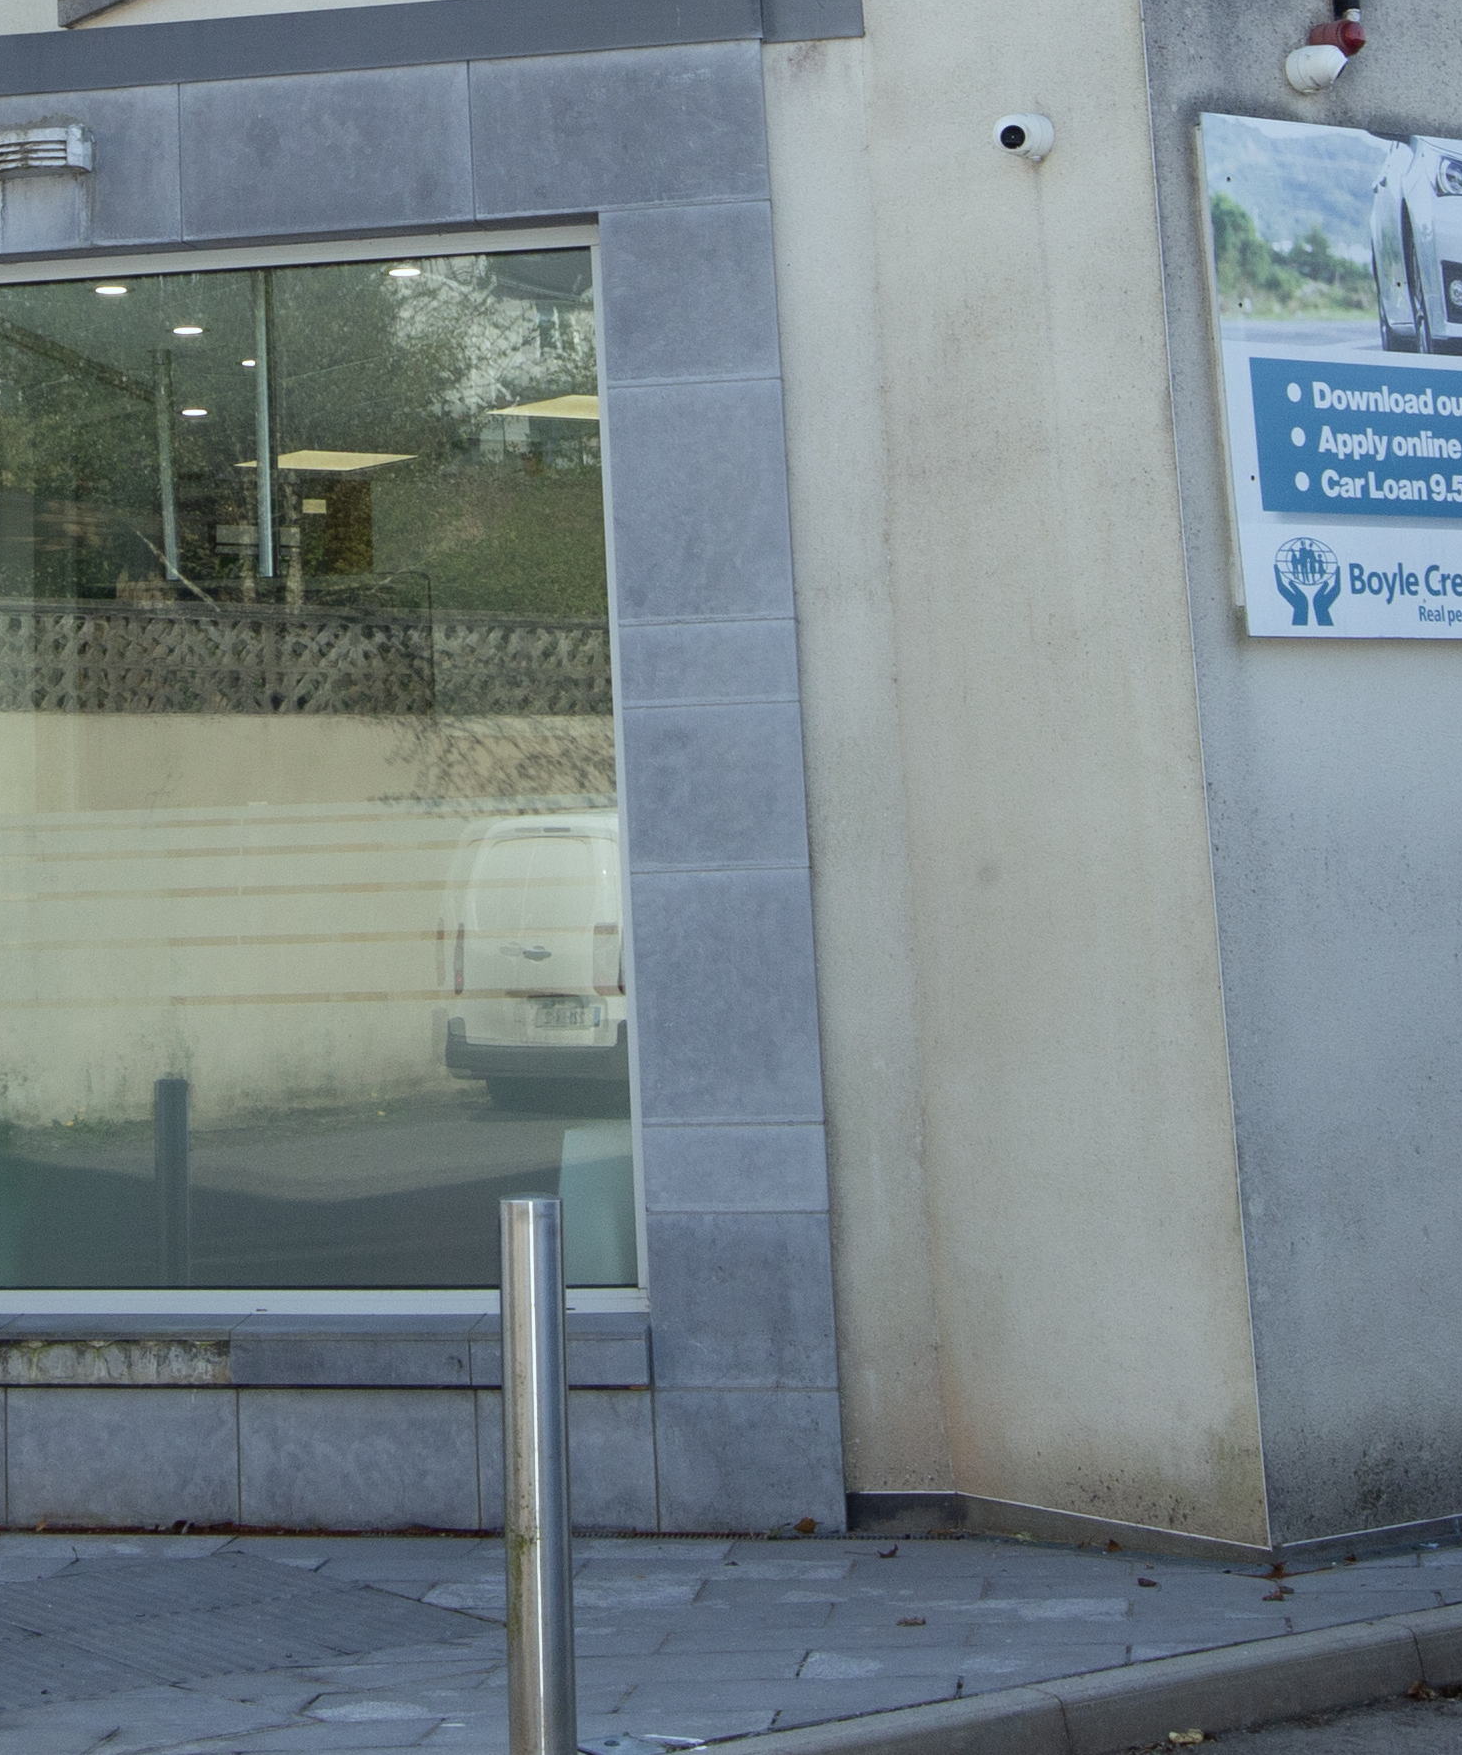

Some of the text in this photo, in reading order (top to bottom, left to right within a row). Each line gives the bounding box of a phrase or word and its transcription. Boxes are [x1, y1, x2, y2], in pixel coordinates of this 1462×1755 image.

[1311, 381, 1435, 416] Download
[1318, 425, 1462, 462] Apply online
[1320, 468, 1366, 499] Car
[1367, 471, 1427, 501] Loan
[1349, 562, 1420, 605] Boyle
[1418, 605, 1446, 623] Real
